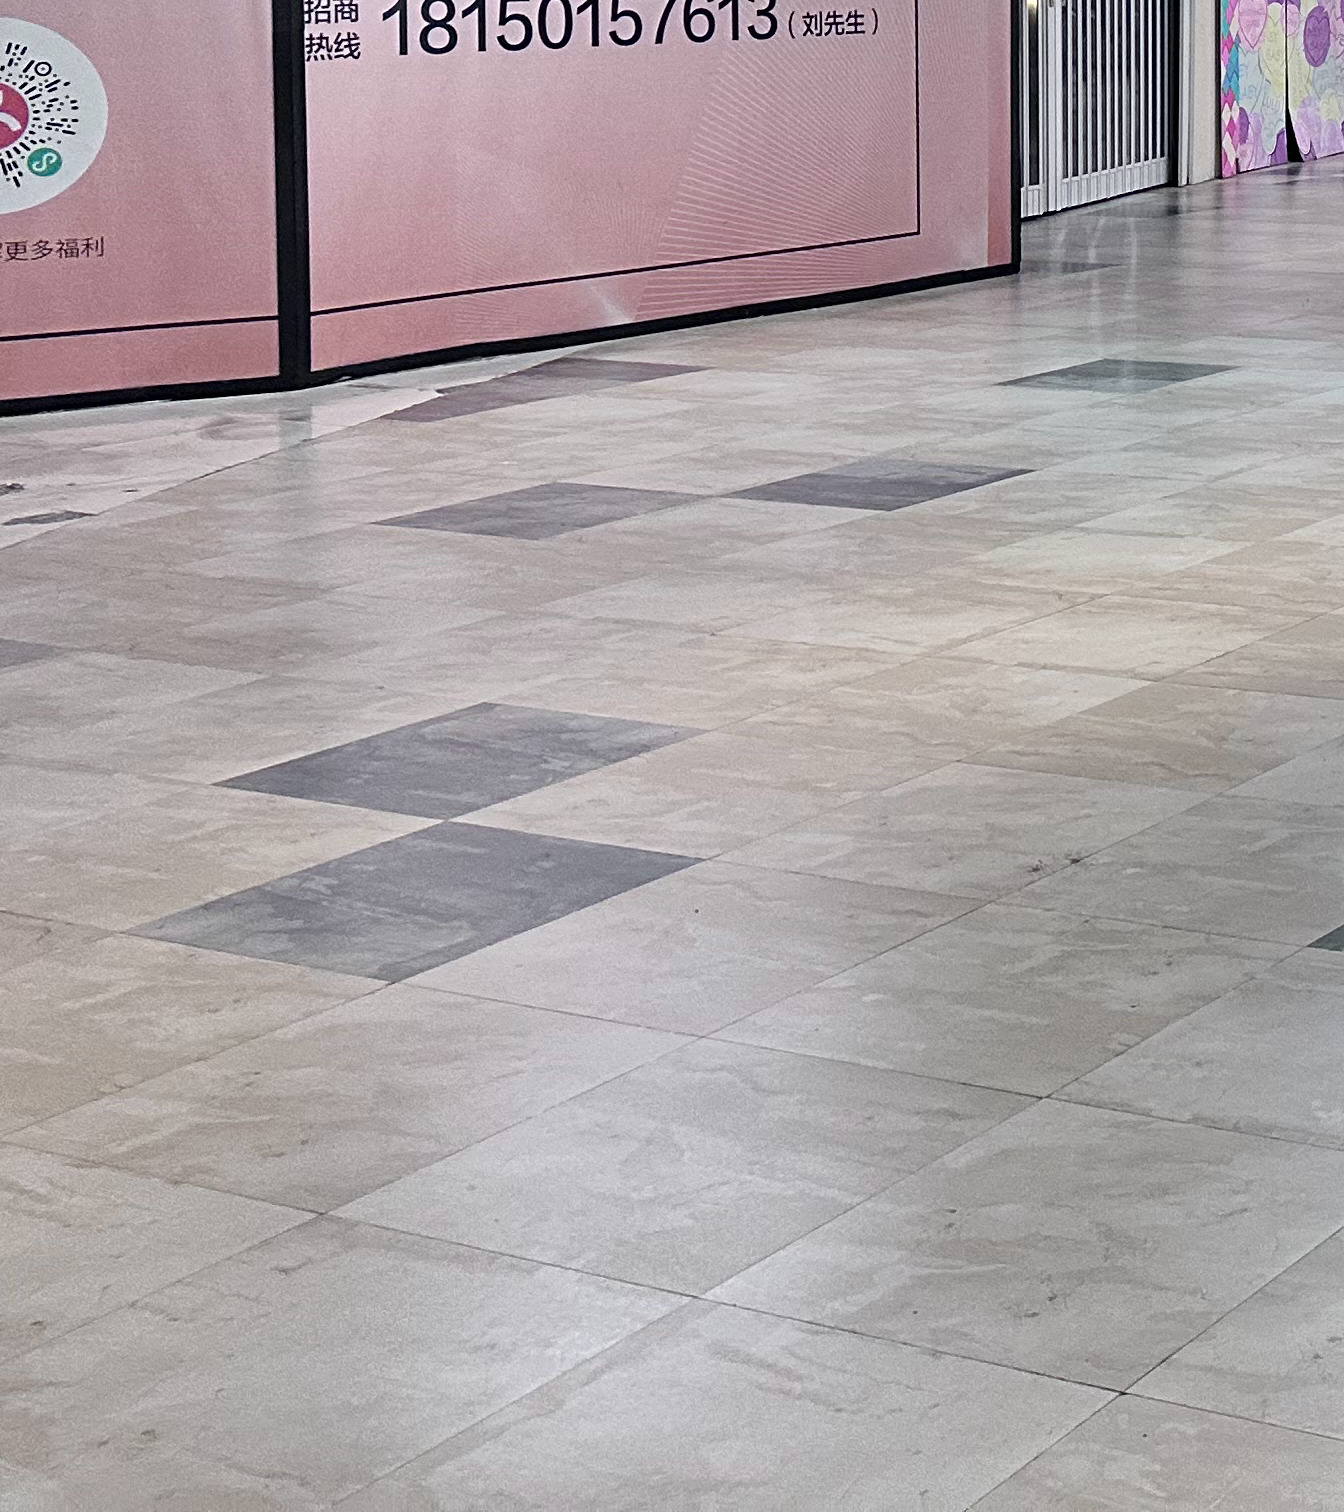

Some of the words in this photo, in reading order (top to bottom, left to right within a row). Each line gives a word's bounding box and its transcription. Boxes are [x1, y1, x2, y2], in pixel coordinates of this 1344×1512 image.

[303, 31, 362, 63] 热线
[0, 235, 105, 263] 更多福利
